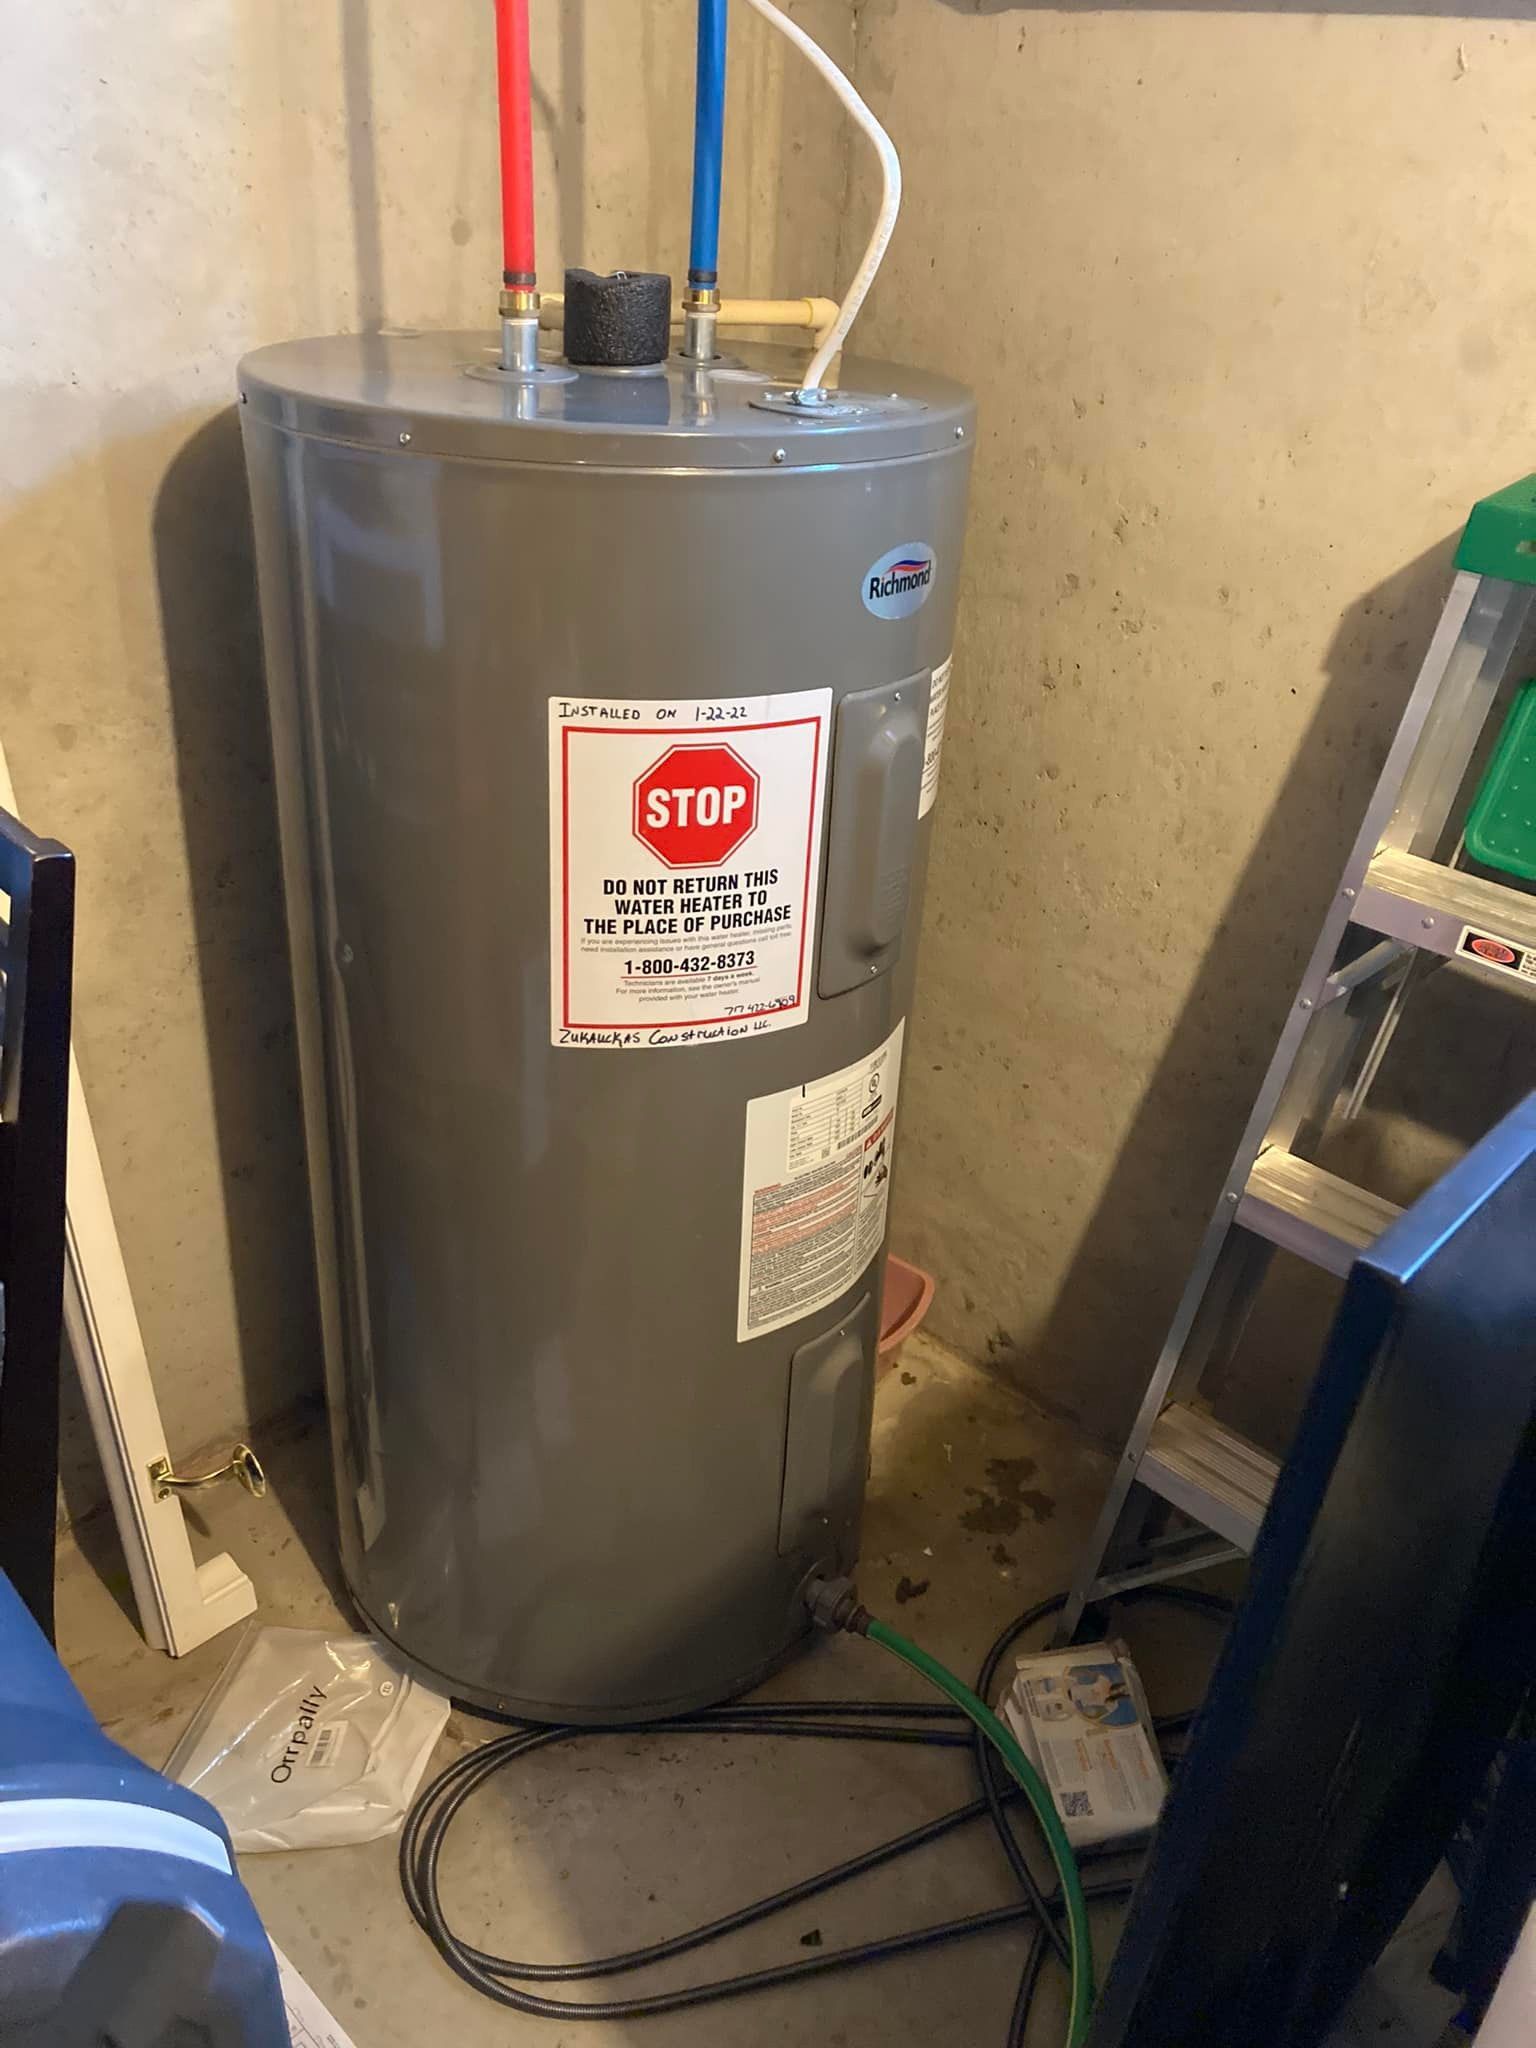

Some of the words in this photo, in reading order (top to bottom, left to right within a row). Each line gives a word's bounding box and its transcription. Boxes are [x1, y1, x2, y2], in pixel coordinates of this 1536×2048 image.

[870, 560, 932, 599] Richmond
[558, 702, 640, 720] INSTALLED
[656, 709, 676, 719] ON
[695, 706, 748, 721] 1-22-22
[646, 785, 746, 829] STOP
[603, 879, 626, 895] DO
[633, 880, 668, 894] NOT
[673, 875, 739, 893] RETURN
[744, 868, 779, 886] THIS
[615, 898, 674, 915] WATER
[680, 894, 742, 912] HEATER
[748, 890, 767, 906] TO
[584, 918, 617, 934] THE
[623, 918, 677, 935] PLACE
[684, 917, 705, 933] OF
[711, 905, 791, 930] PURCHASE
[753, 927, 775, 935] missing
[702, 942, 726, 950] general
[728, 938, 756, 947] questions
[624, 950, 754, 974] 1-800-432-8373
[648, 986, 686, 994] information,
[714, 982, 736, 990] owner's
[739, 977, 760, 986] manual
[713, 974, 728, 982] days
[271, 1685, 328, 1783] Orrpally
